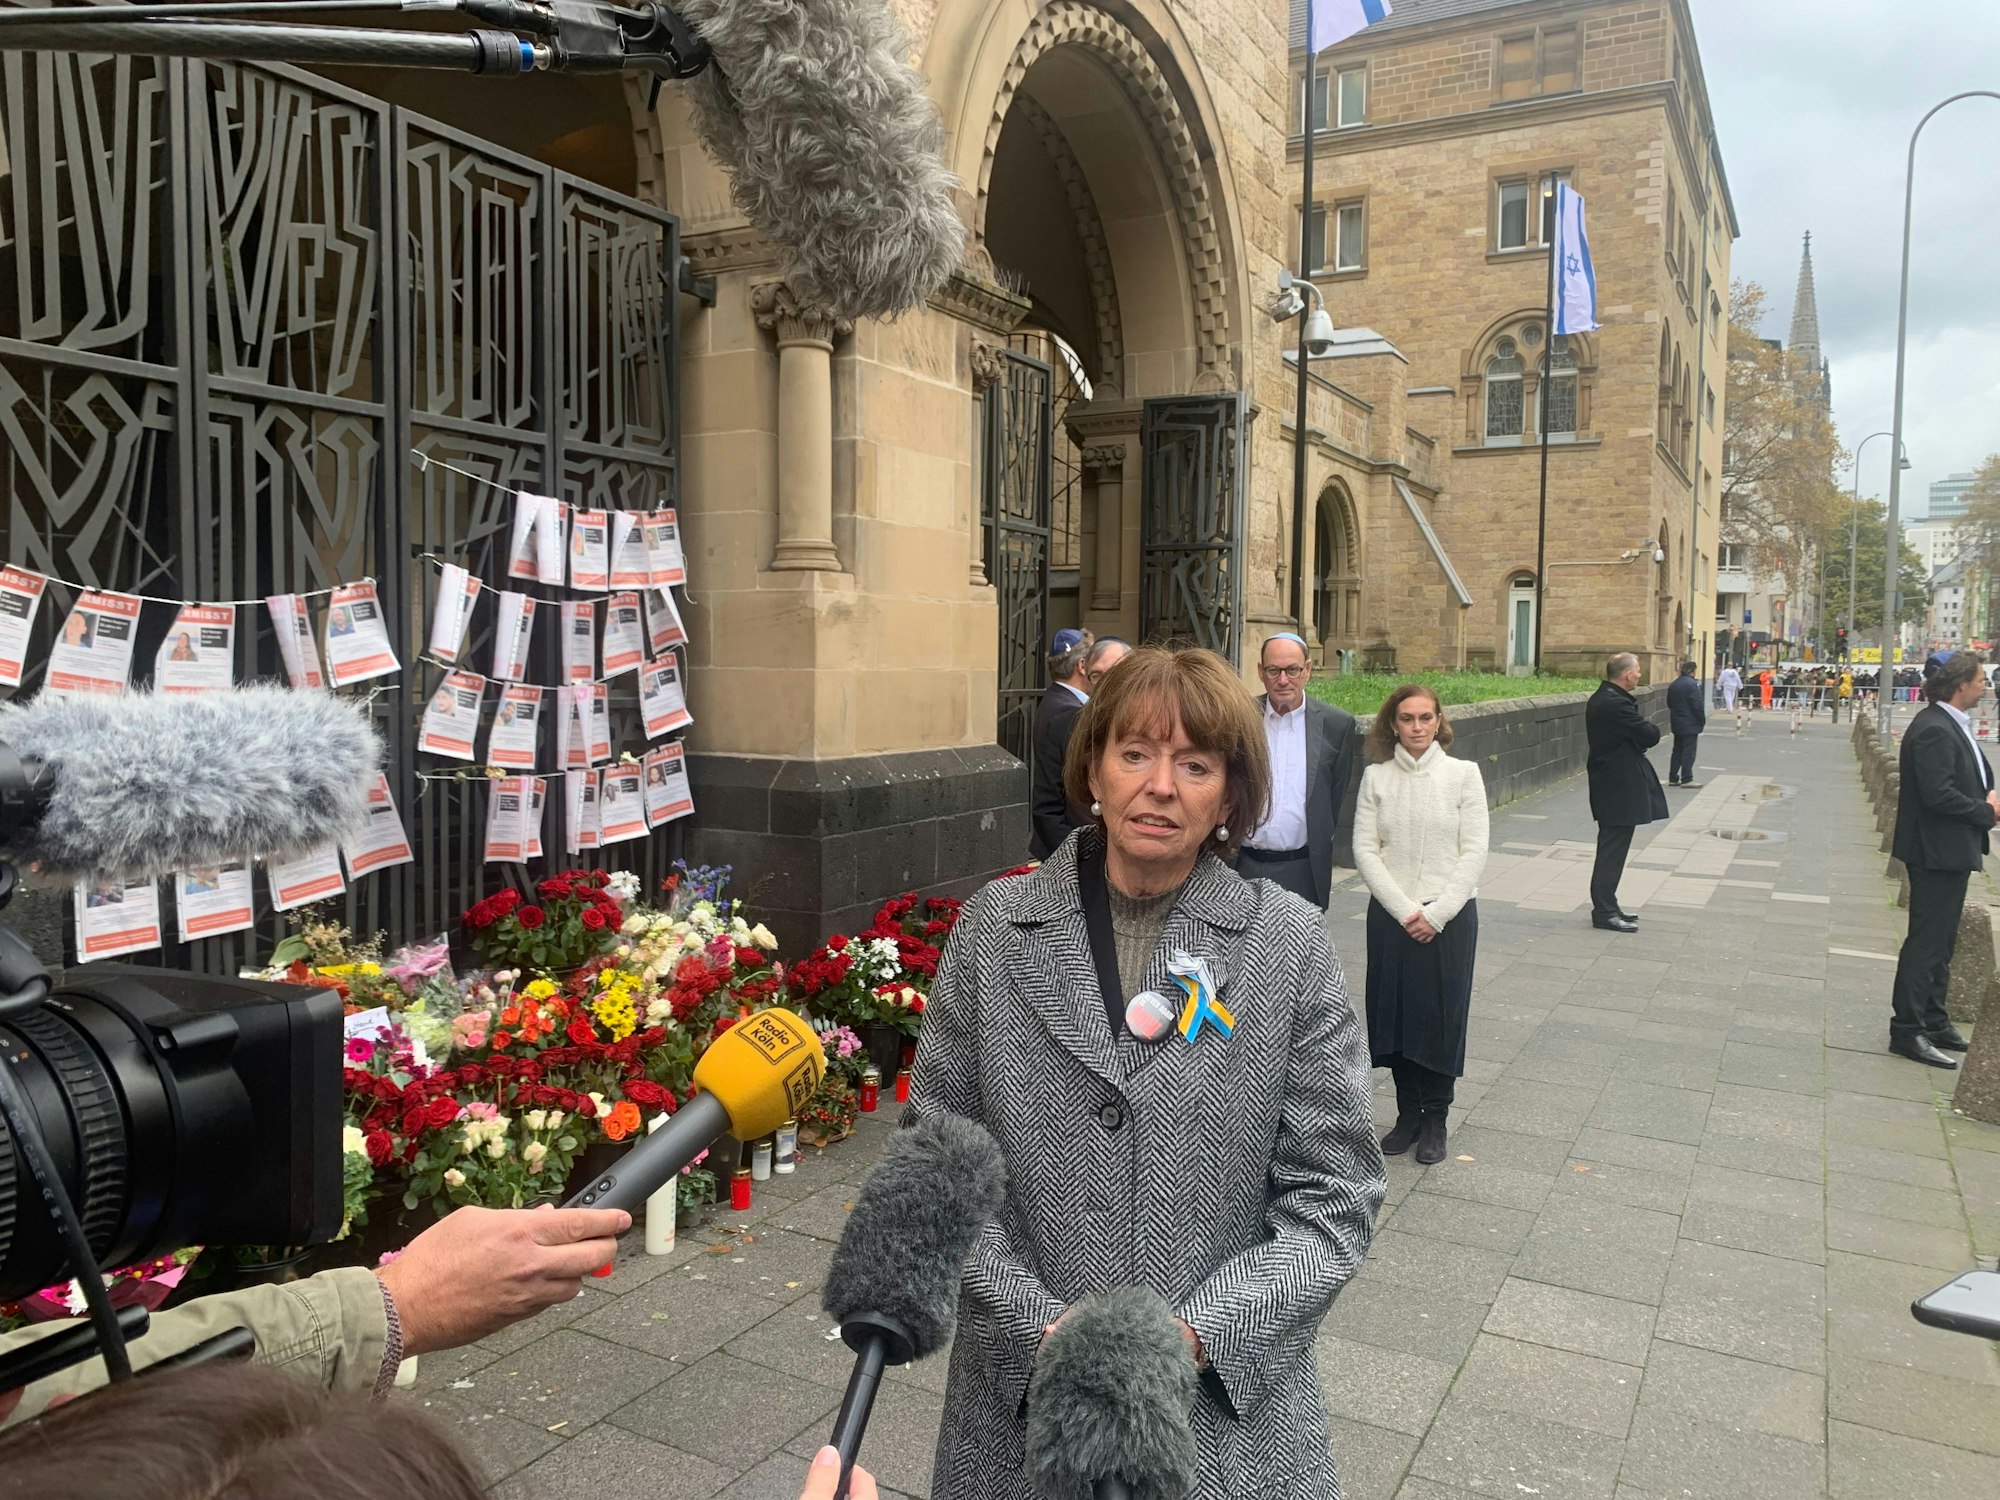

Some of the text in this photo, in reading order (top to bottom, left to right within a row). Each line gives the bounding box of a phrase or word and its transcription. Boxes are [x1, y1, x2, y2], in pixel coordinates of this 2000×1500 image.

[181, 609, 229, 620] RMISST
[750, 1028, 776, 1051] Köln
[759, 1018, 790, 1045] Radio
[792, 1080, 805, 1105] Köln
[802, 1067, 814, 1097] Radio
